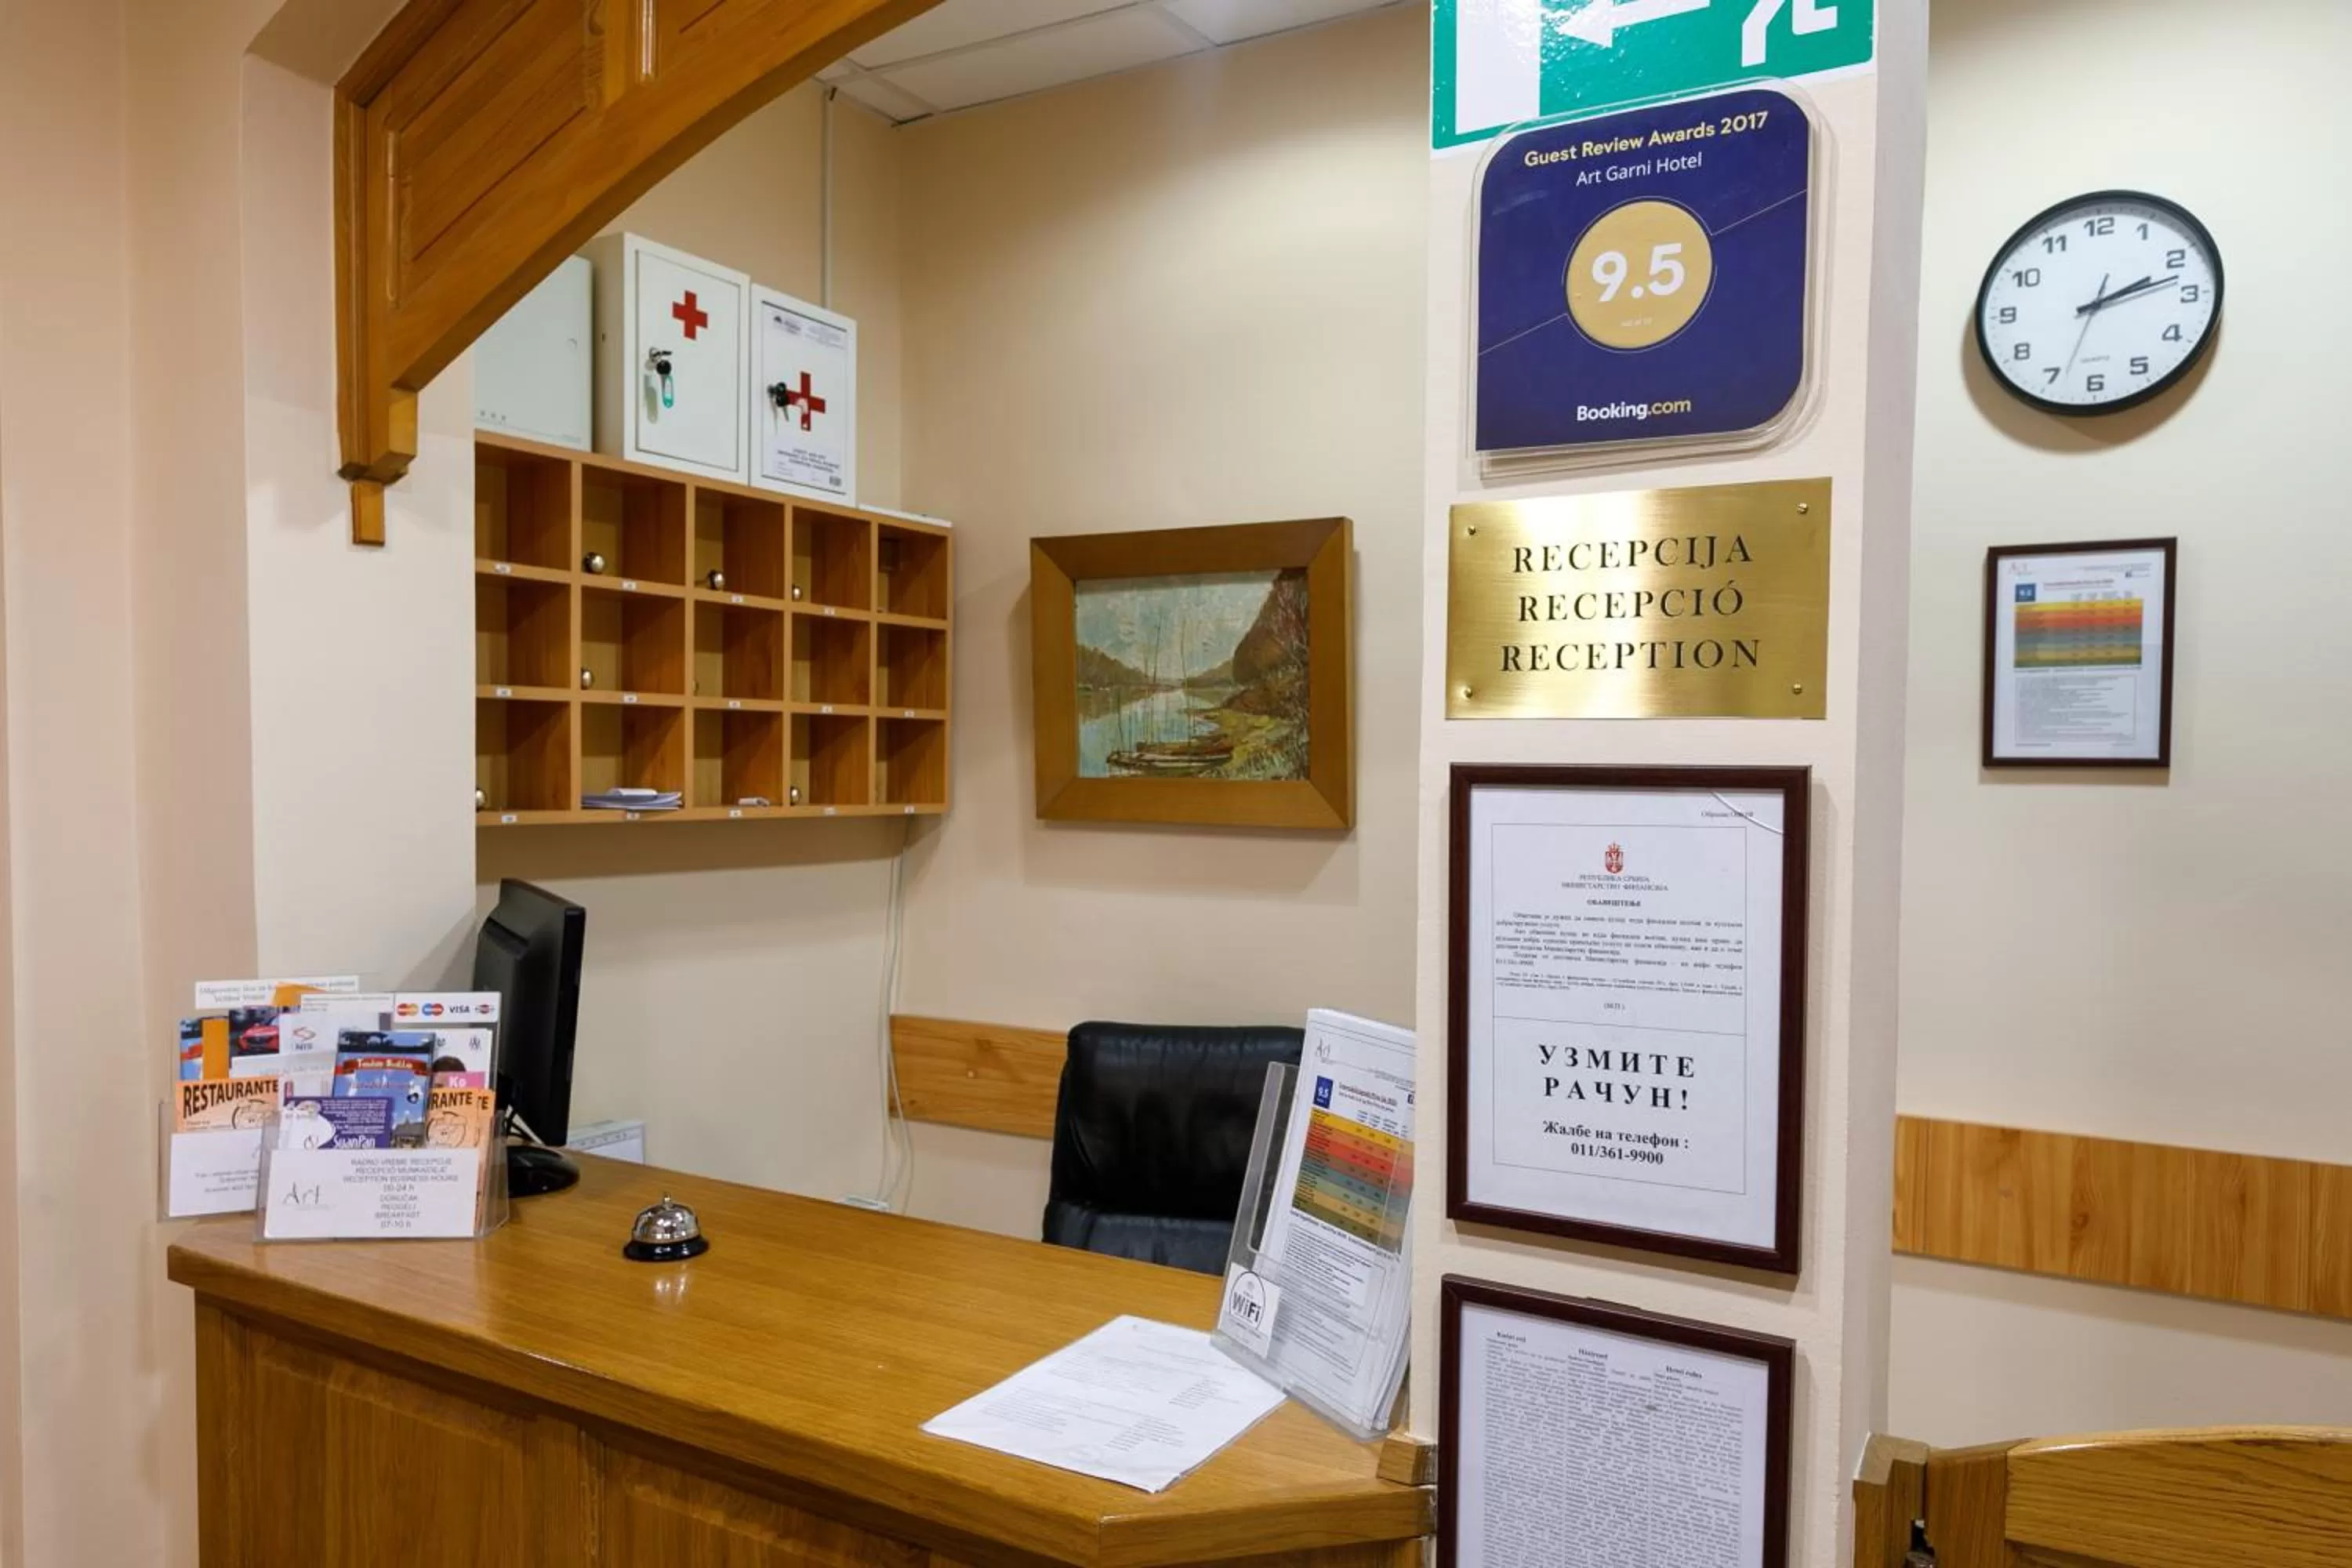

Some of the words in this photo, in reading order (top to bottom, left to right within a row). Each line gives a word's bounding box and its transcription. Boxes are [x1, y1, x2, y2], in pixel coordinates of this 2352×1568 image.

[1525, 144, 1577, 167] Guest
[1582, 136, 1643, 158] Review
[1648, 122, 1715, 147] Awards
[1720, 111, 1769, 135] 2017
[1576, 170, 1602, 187] Art
[1606, 159, 1651, 183] Garni
[1657, 152, 1703, 172] Hotel
[2083, 217, 2115, 237] 12
[2136, 223, 2149, 240] 1
[2042, 234, 2067, 254] 11
[2165, 249, 2186, 270] 2
[1592, 243, 1686, 302] 9.5
[2013, 268, 2040, 288] 10
[2180, 284, 2199, 303] 3
[1999, 307, 2017, 325] 9
[2161, 324, 2183, 342] 4
[2013, 342, 2031, 361] 8
[2042, 367, 2061, 385] 7
[2129, 356, 2149, 376] 5
[2086, 374, 2105, 392] 6
[1577, 398, 1691, 421] Booking.com
[1513, 534, 1754, 573] RECEPCIJA
[1518, 580, 1744, 622] RECEPCIÓ
[1501, 639, 1761, 672] RECEPTION
[449, 1005, 470, 1014] VISA
[1538, 1044, 1695, 1078] УЗМИТЕ
[183, 1080, 279, 1120] RESTAURANTE
[1544, 1077, 1689, 1111] РАЧУН!
[1543, 1121, 1591, 1138] Жалбе
[1595, 1128, 1613, 1141] на
[1616, 1131, 1679, 1149] телефон
[1570, 1143, 1664, 1165] 011/361-9900
[282, 1182, 320, 1204] Art
[1232, 1291, 1262, 1323] WiFi
